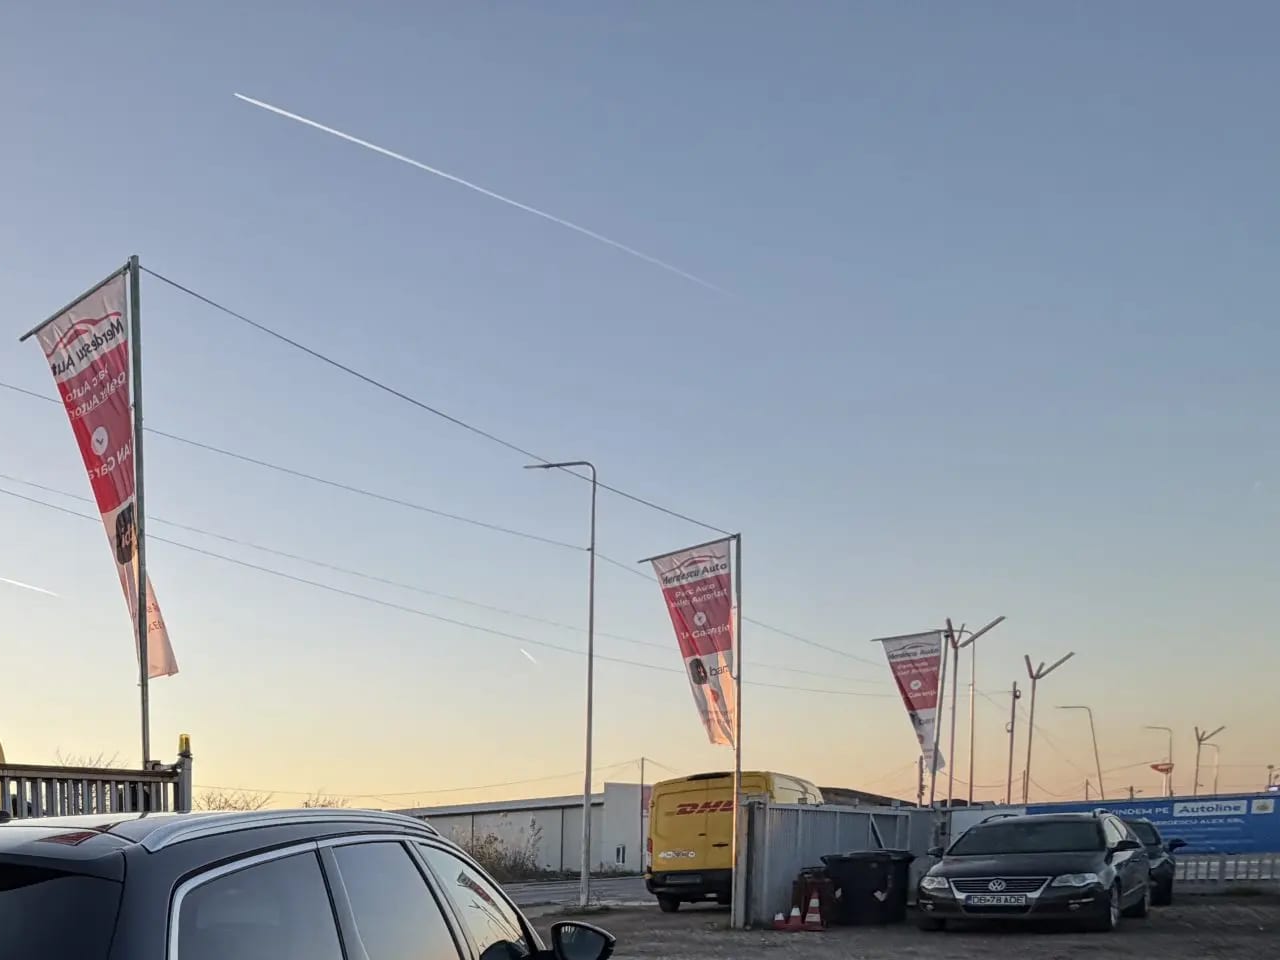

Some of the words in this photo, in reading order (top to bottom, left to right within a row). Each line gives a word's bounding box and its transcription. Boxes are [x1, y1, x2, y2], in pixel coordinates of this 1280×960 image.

[702, 562, 727, 576] Auto
[676, 800, 734, 816] DHL
[1155, 807, 1169, 815] PE
[1179, 801, 1242, 814] Autoline
